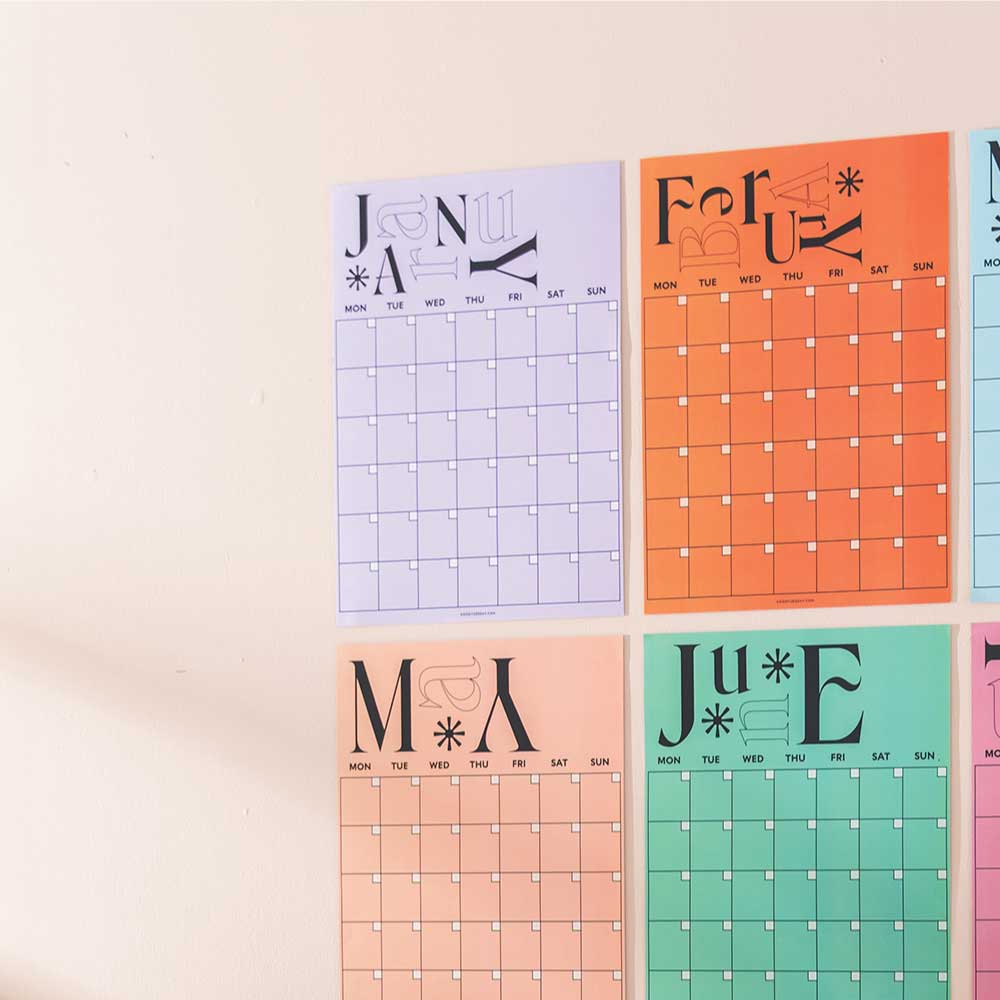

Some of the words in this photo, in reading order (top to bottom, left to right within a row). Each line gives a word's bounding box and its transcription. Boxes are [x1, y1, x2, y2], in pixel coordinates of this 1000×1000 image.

[653, 280, 678, 290] MON
[698, 277, 717, 288] TUE
[739, 274, 762, 284] WED
[782, 271, 804, 281] THU
[828, 268, 844, 278] FRI
[870, 264, 889, 275] SAT
[913, 261, 934, 272] SUN
[344, 304, 367, 313] MON
[386, 300, 404, 311] TUE
[424, 298, 446, 308] WED
[465, 295, 485, 305] THU
[508, 292, 523, 302] FRI
[547, 289, 565, 299] SAT
[587, 286, 607, 296] SUN
[349, 762, 372, 771] MON
[391, 761, 408, 770] TUE
[429, 761, 450, 770] WED
[469, 760, 489, 769] THU
[512, 759, 526, 768] FRI
[550, 758, 568, 767] SAT
[590, 757, 610, 767] SUN
[657, 756, 681, 765] MON
[701, 755, 720, 764] TUE
[742, 754, 764, 763] WED
[784, 753, 806, 763] THU
[830, 753, 846, 762] FRI
[871, 751, 891, 761] SAT
[914, 751, 935, 761] SUN
